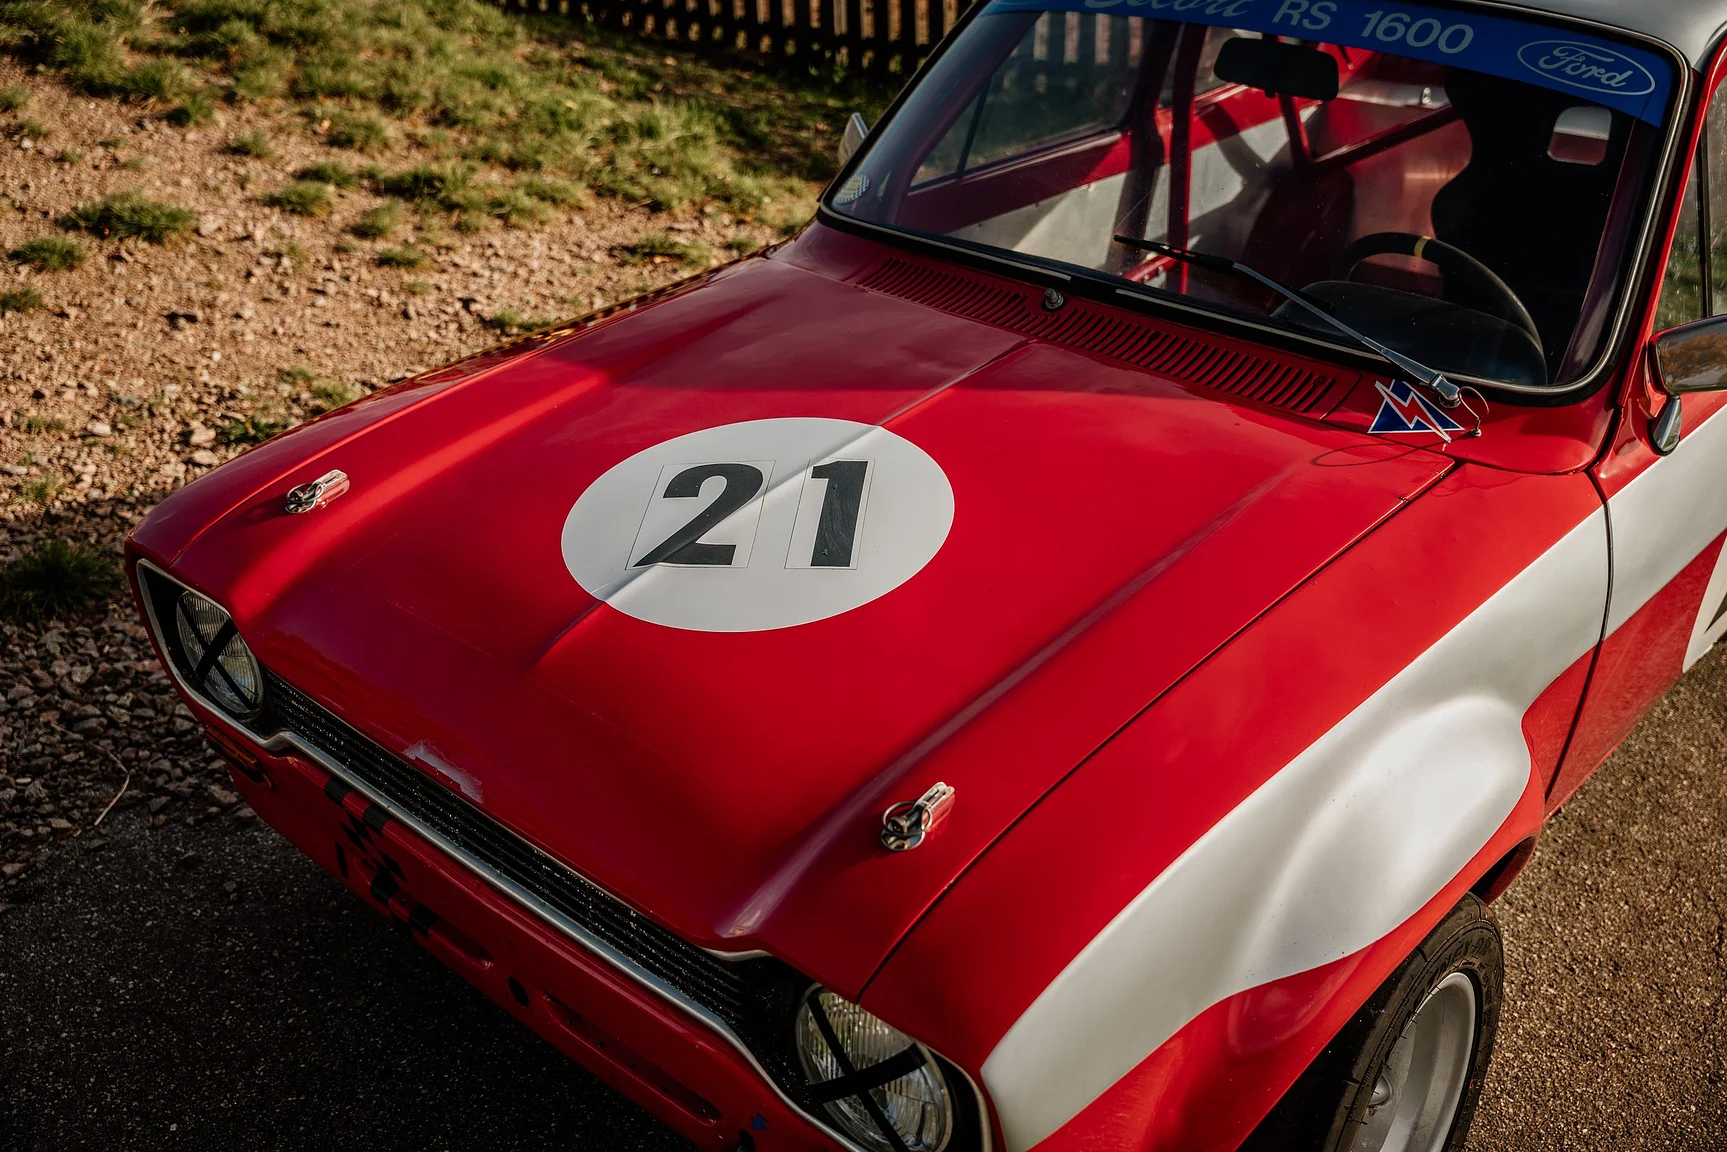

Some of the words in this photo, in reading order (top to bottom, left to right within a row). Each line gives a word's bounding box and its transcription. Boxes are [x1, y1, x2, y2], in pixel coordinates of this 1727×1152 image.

[1084, 0, 1256, 18] ort
[1272, 0, 1338, 30] RS
[1360, 10, 1474, 54] 1600
[1538, 46, 1634, 88] Ford
[632, 460, 869, 568] 21
